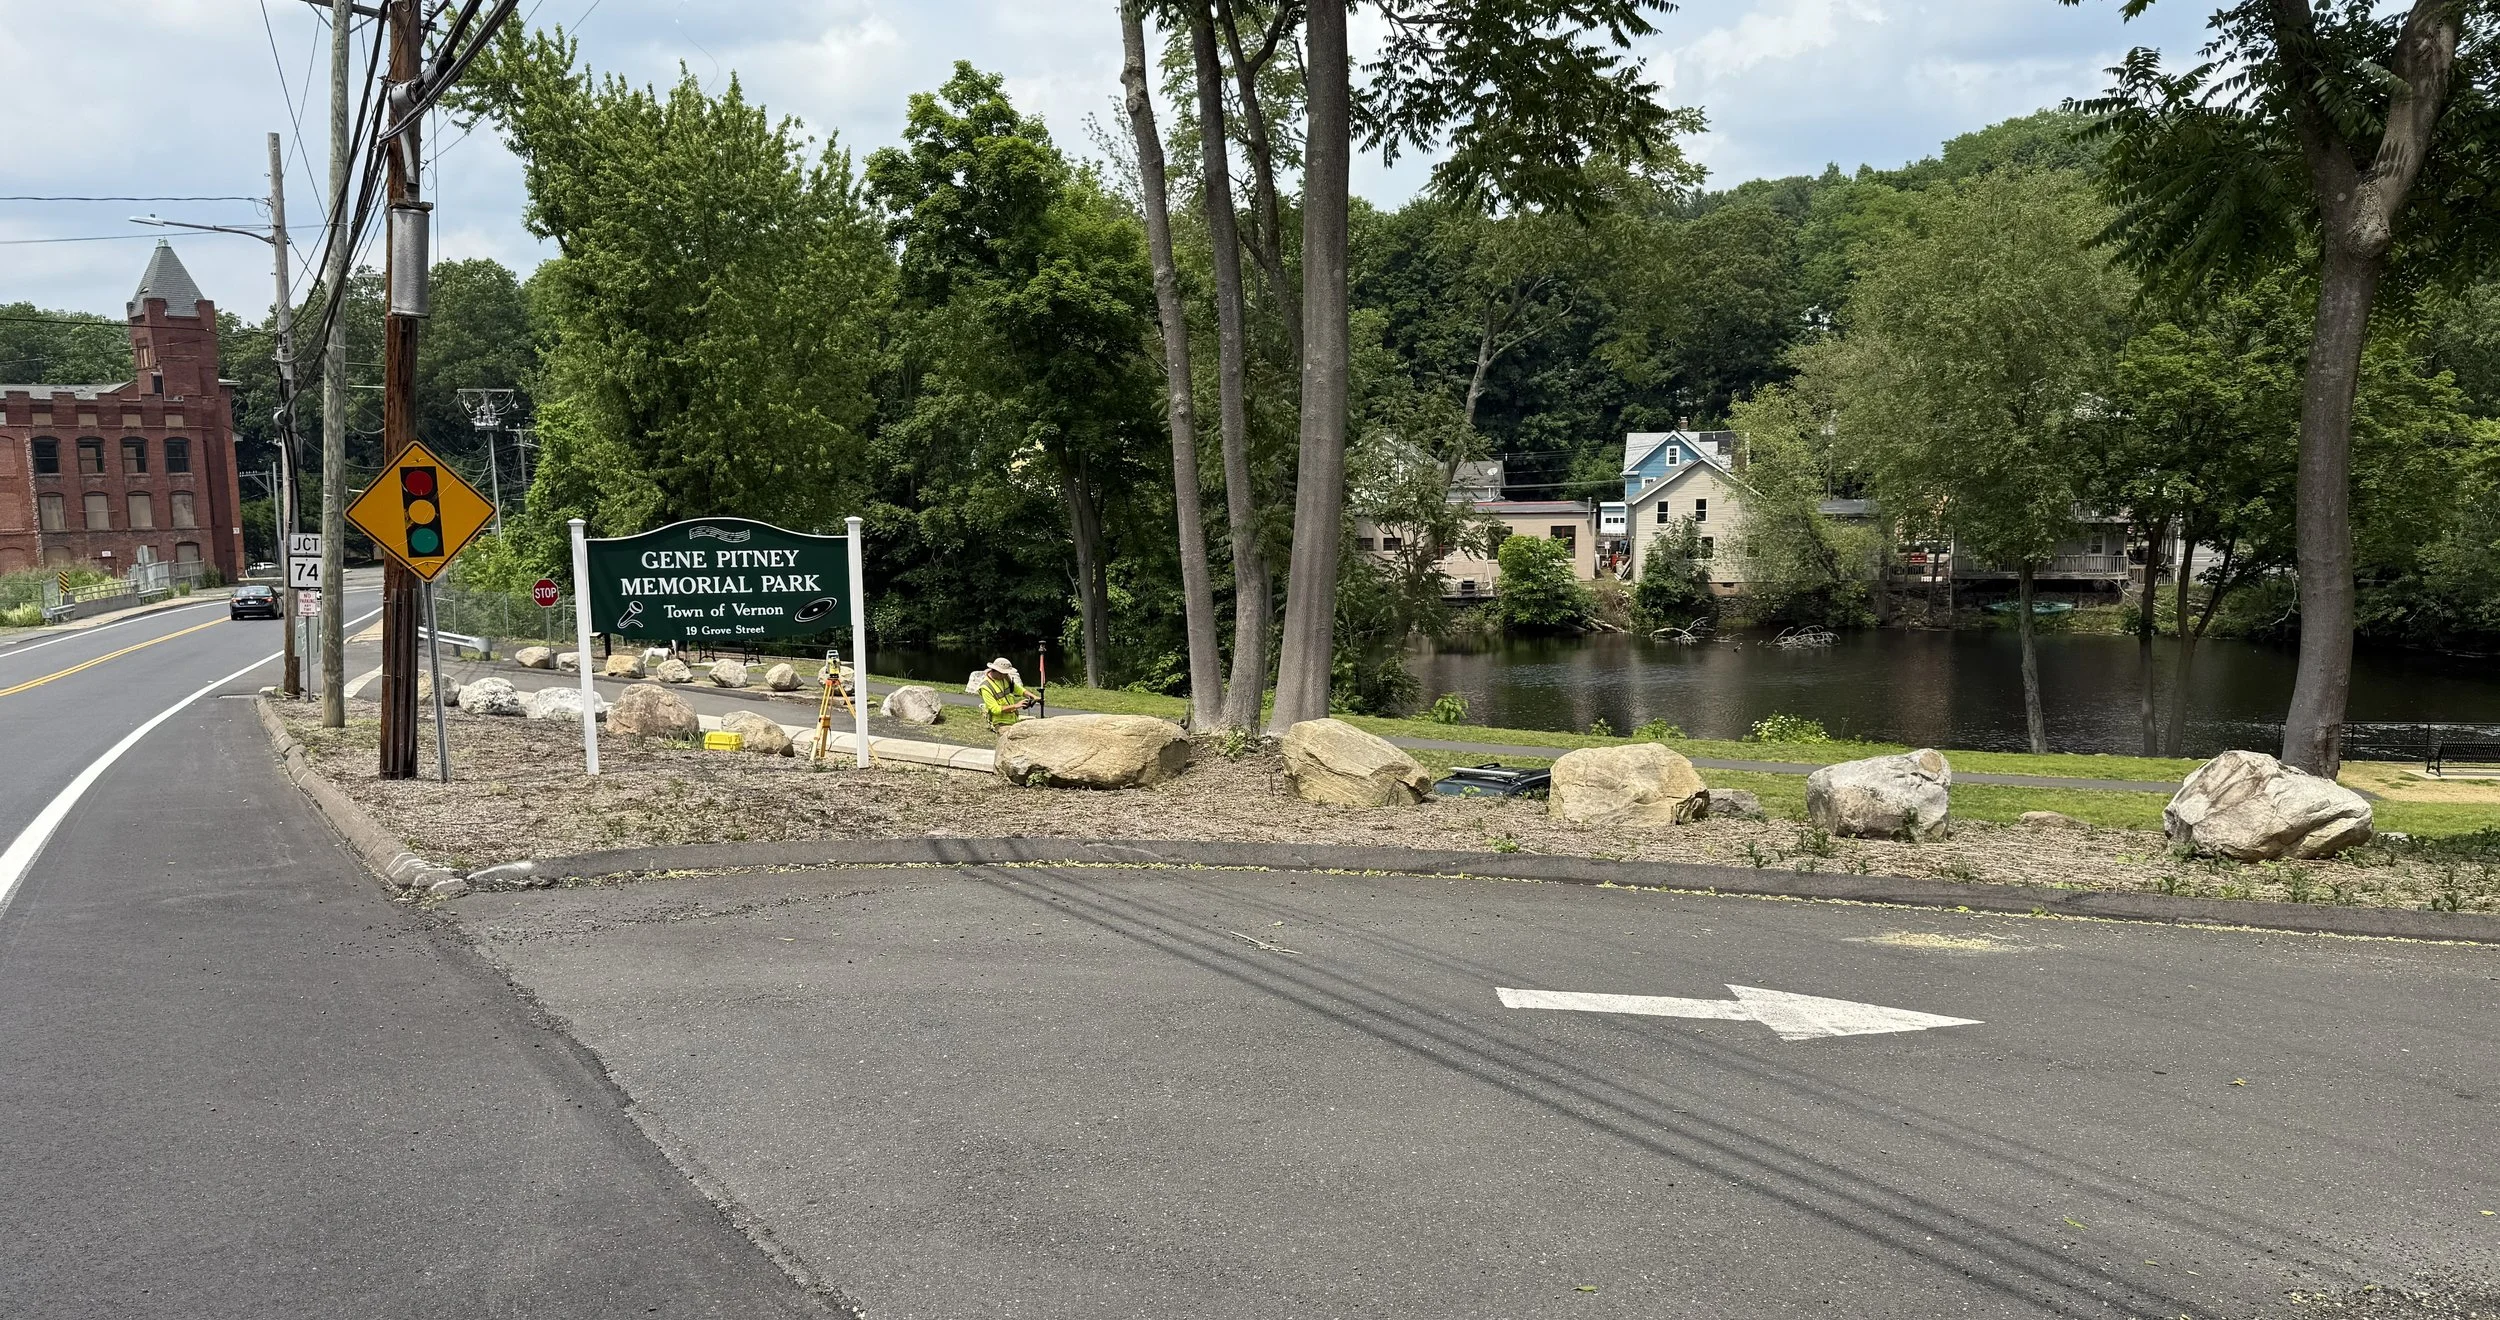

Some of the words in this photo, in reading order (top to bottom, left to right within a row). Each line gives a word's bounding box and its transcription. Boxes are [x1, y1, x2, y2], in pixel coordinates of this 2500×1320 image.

[293, 537, 319, 551] JCT
[641, 550, 708, 569] GENE
[715, 549, 800, 568] PITNEY
[295, 563, 318, 581] 74
[535, 587, 557, 598] STOP
[620, 575, 753, 596] MEMORIAL
[761, 574, 821, 593] PARK
[663, 604, 704, 619] Town
[710, 603, 725, 617] of
[732, 603, 784, 617] Vernon
[685, 625, 698, 636] 19
[701, 625, 732, 635] Grove
[735, 624, 765, 635] Street
